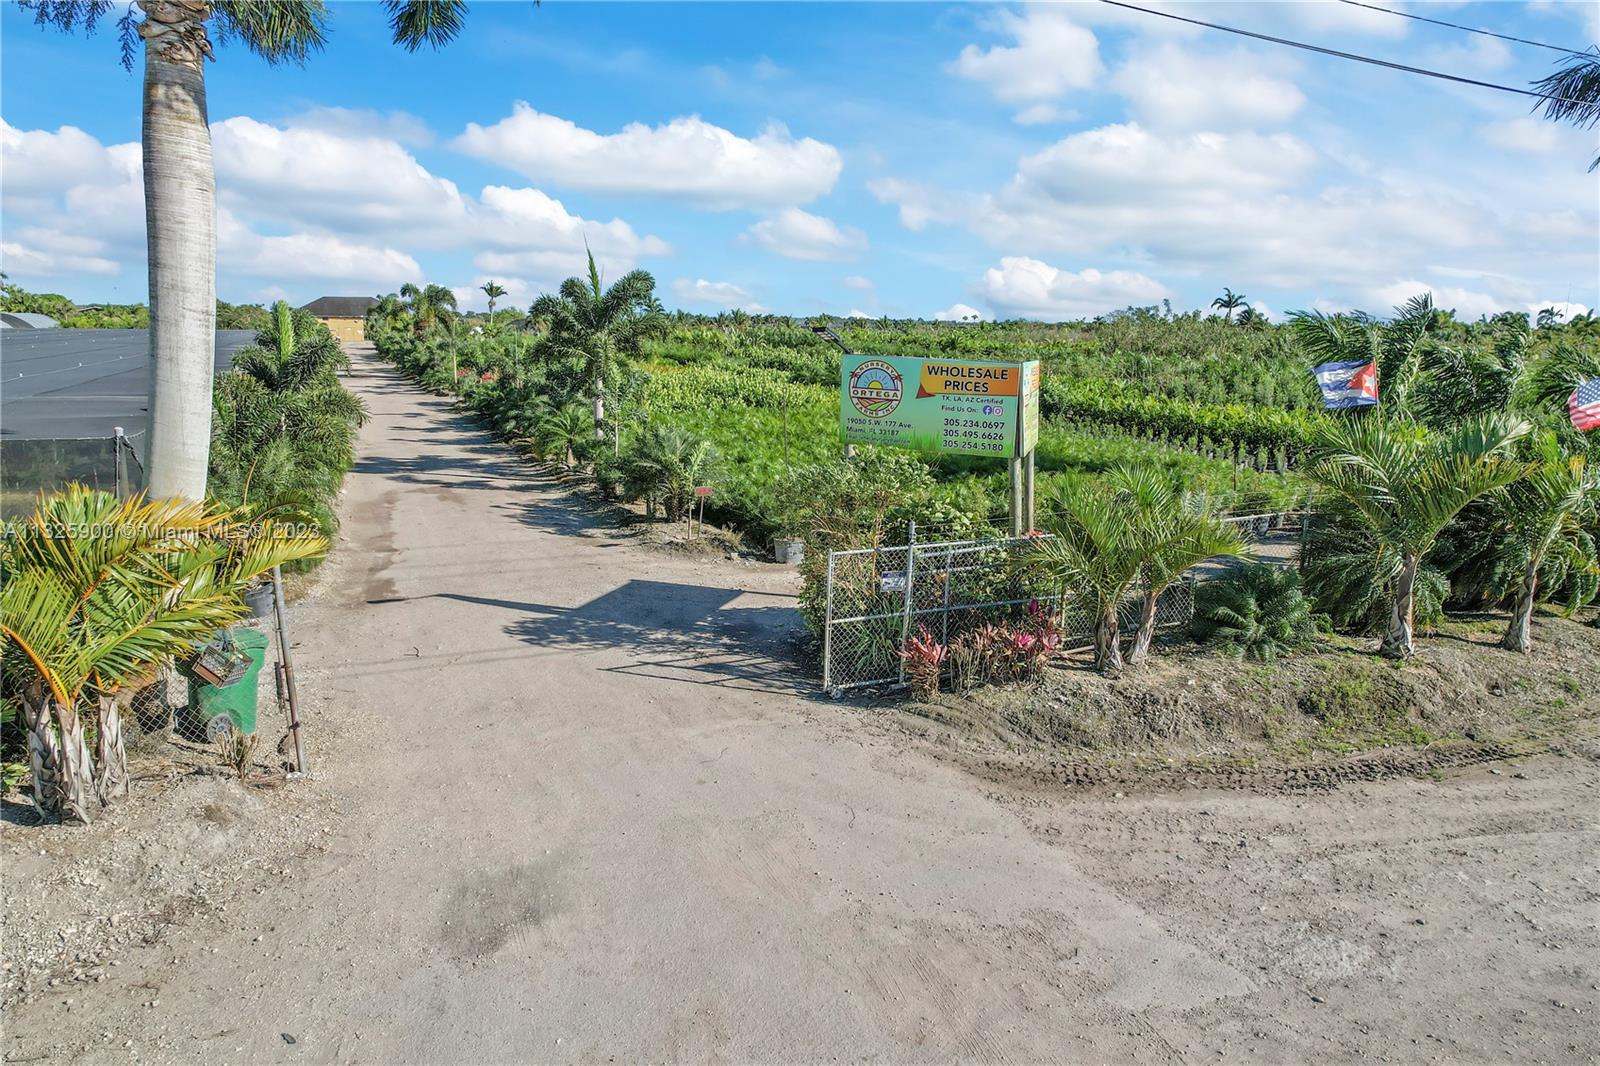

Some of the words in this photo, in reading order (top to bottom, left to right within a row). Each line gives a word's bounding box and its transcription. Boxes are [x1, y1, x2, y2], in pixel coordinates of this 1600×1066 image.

[859, 362, 895, 375] NURSERY
[927, 366, 1009, 380] WHOLESALE
[944, 380, 989, 393] PRICES
[852, 389, 899, 398] ORTEGA
[975, 397, 1004, 405] Certified
[855, 402, 879, 416] FARMS
[943, 418, 1005, 430] 305.234.0697
[943, 429, 1004, 441] 305.495.6626
[942, 440, 1004, 451] 305.254.5180
